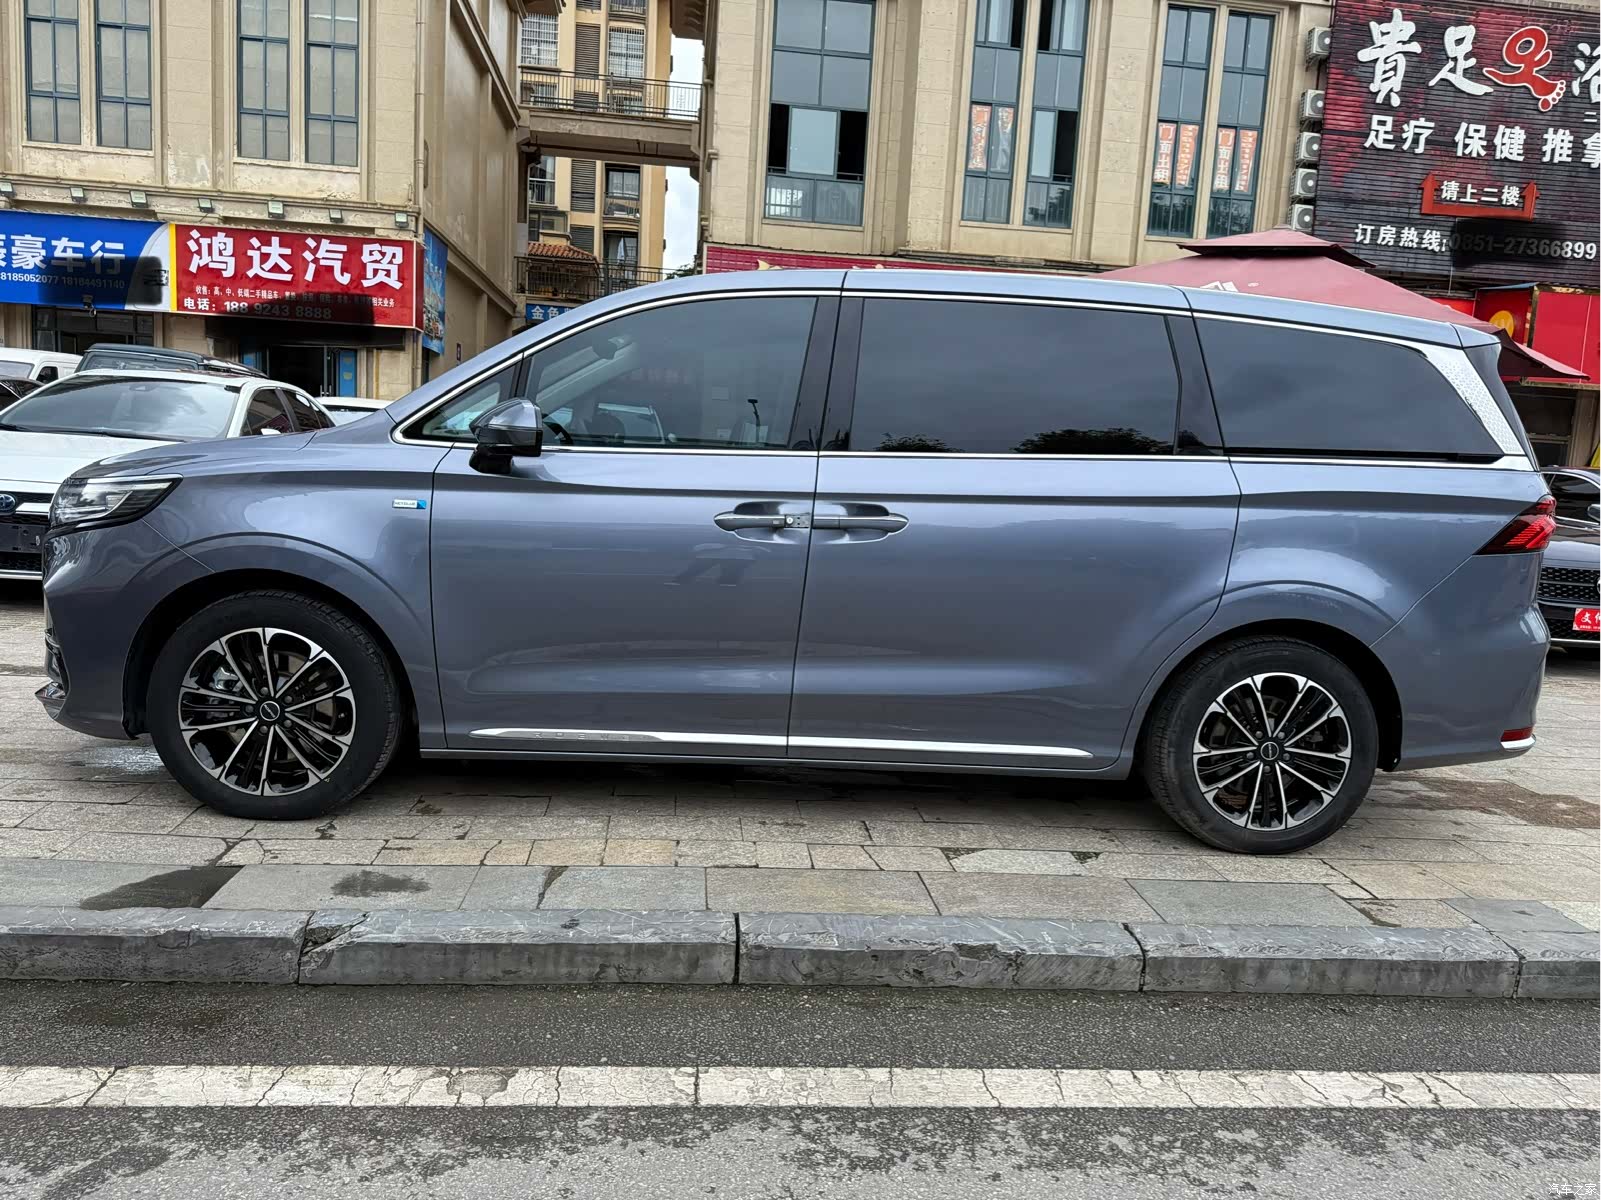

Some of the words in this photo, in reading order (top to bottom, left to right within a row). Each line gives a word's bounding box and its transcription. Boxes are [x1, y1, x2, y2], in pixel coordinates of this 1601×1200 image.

[1364, 114, 1435, 154] 足疗
[1454, 121, 1527, 162] 保健
[1440, 180, 1521, 207] 请上二楼
[0, 234, 126, 275] 豪车行
[186, 229, 404, 290] 鸿达汽贸
